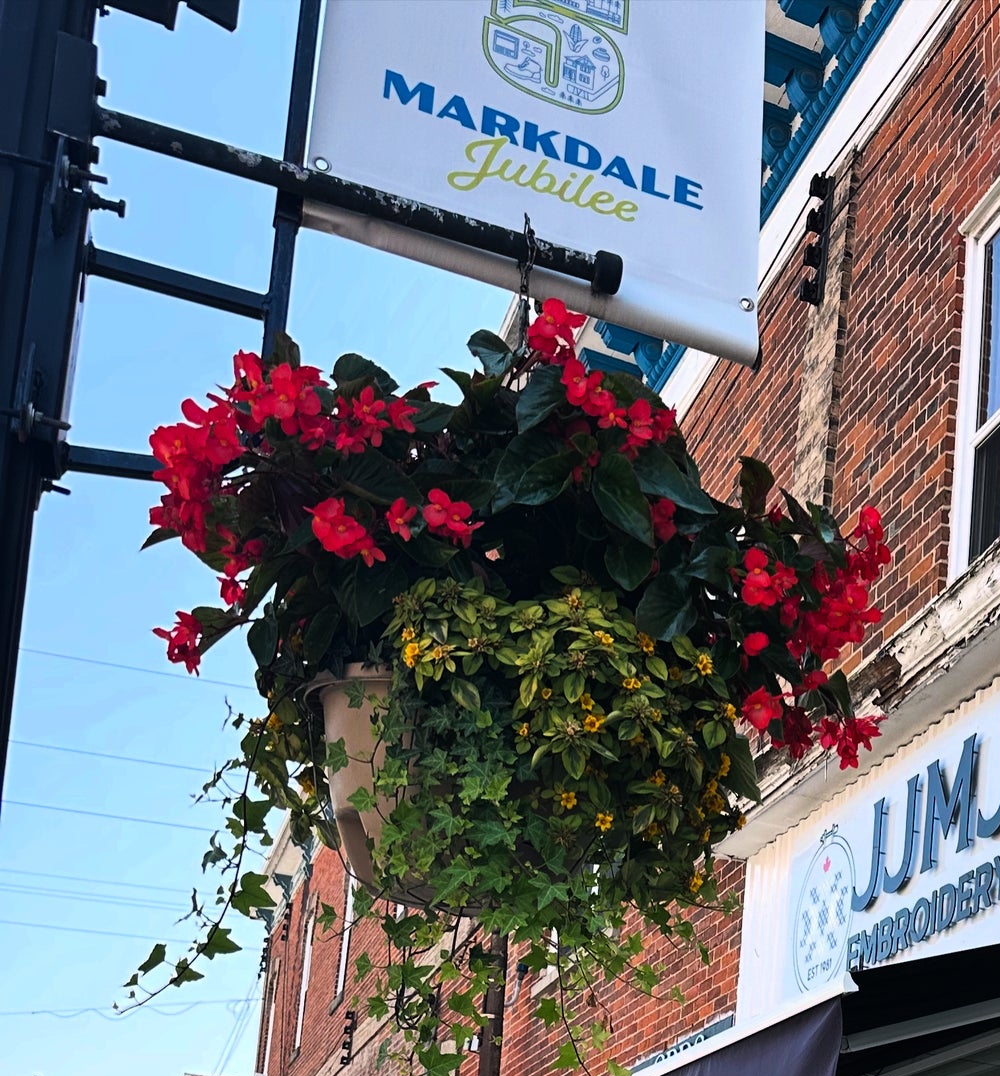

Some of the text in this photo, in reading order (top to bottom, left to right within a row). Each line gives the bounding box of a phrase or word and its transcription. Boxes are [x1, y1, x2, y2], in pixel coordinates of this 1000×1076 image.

[382, 69, 704, 211] MARKDALE
[447, 135, 639, 223] Jubilee
[807, 958, 833, 981] EST 1981
